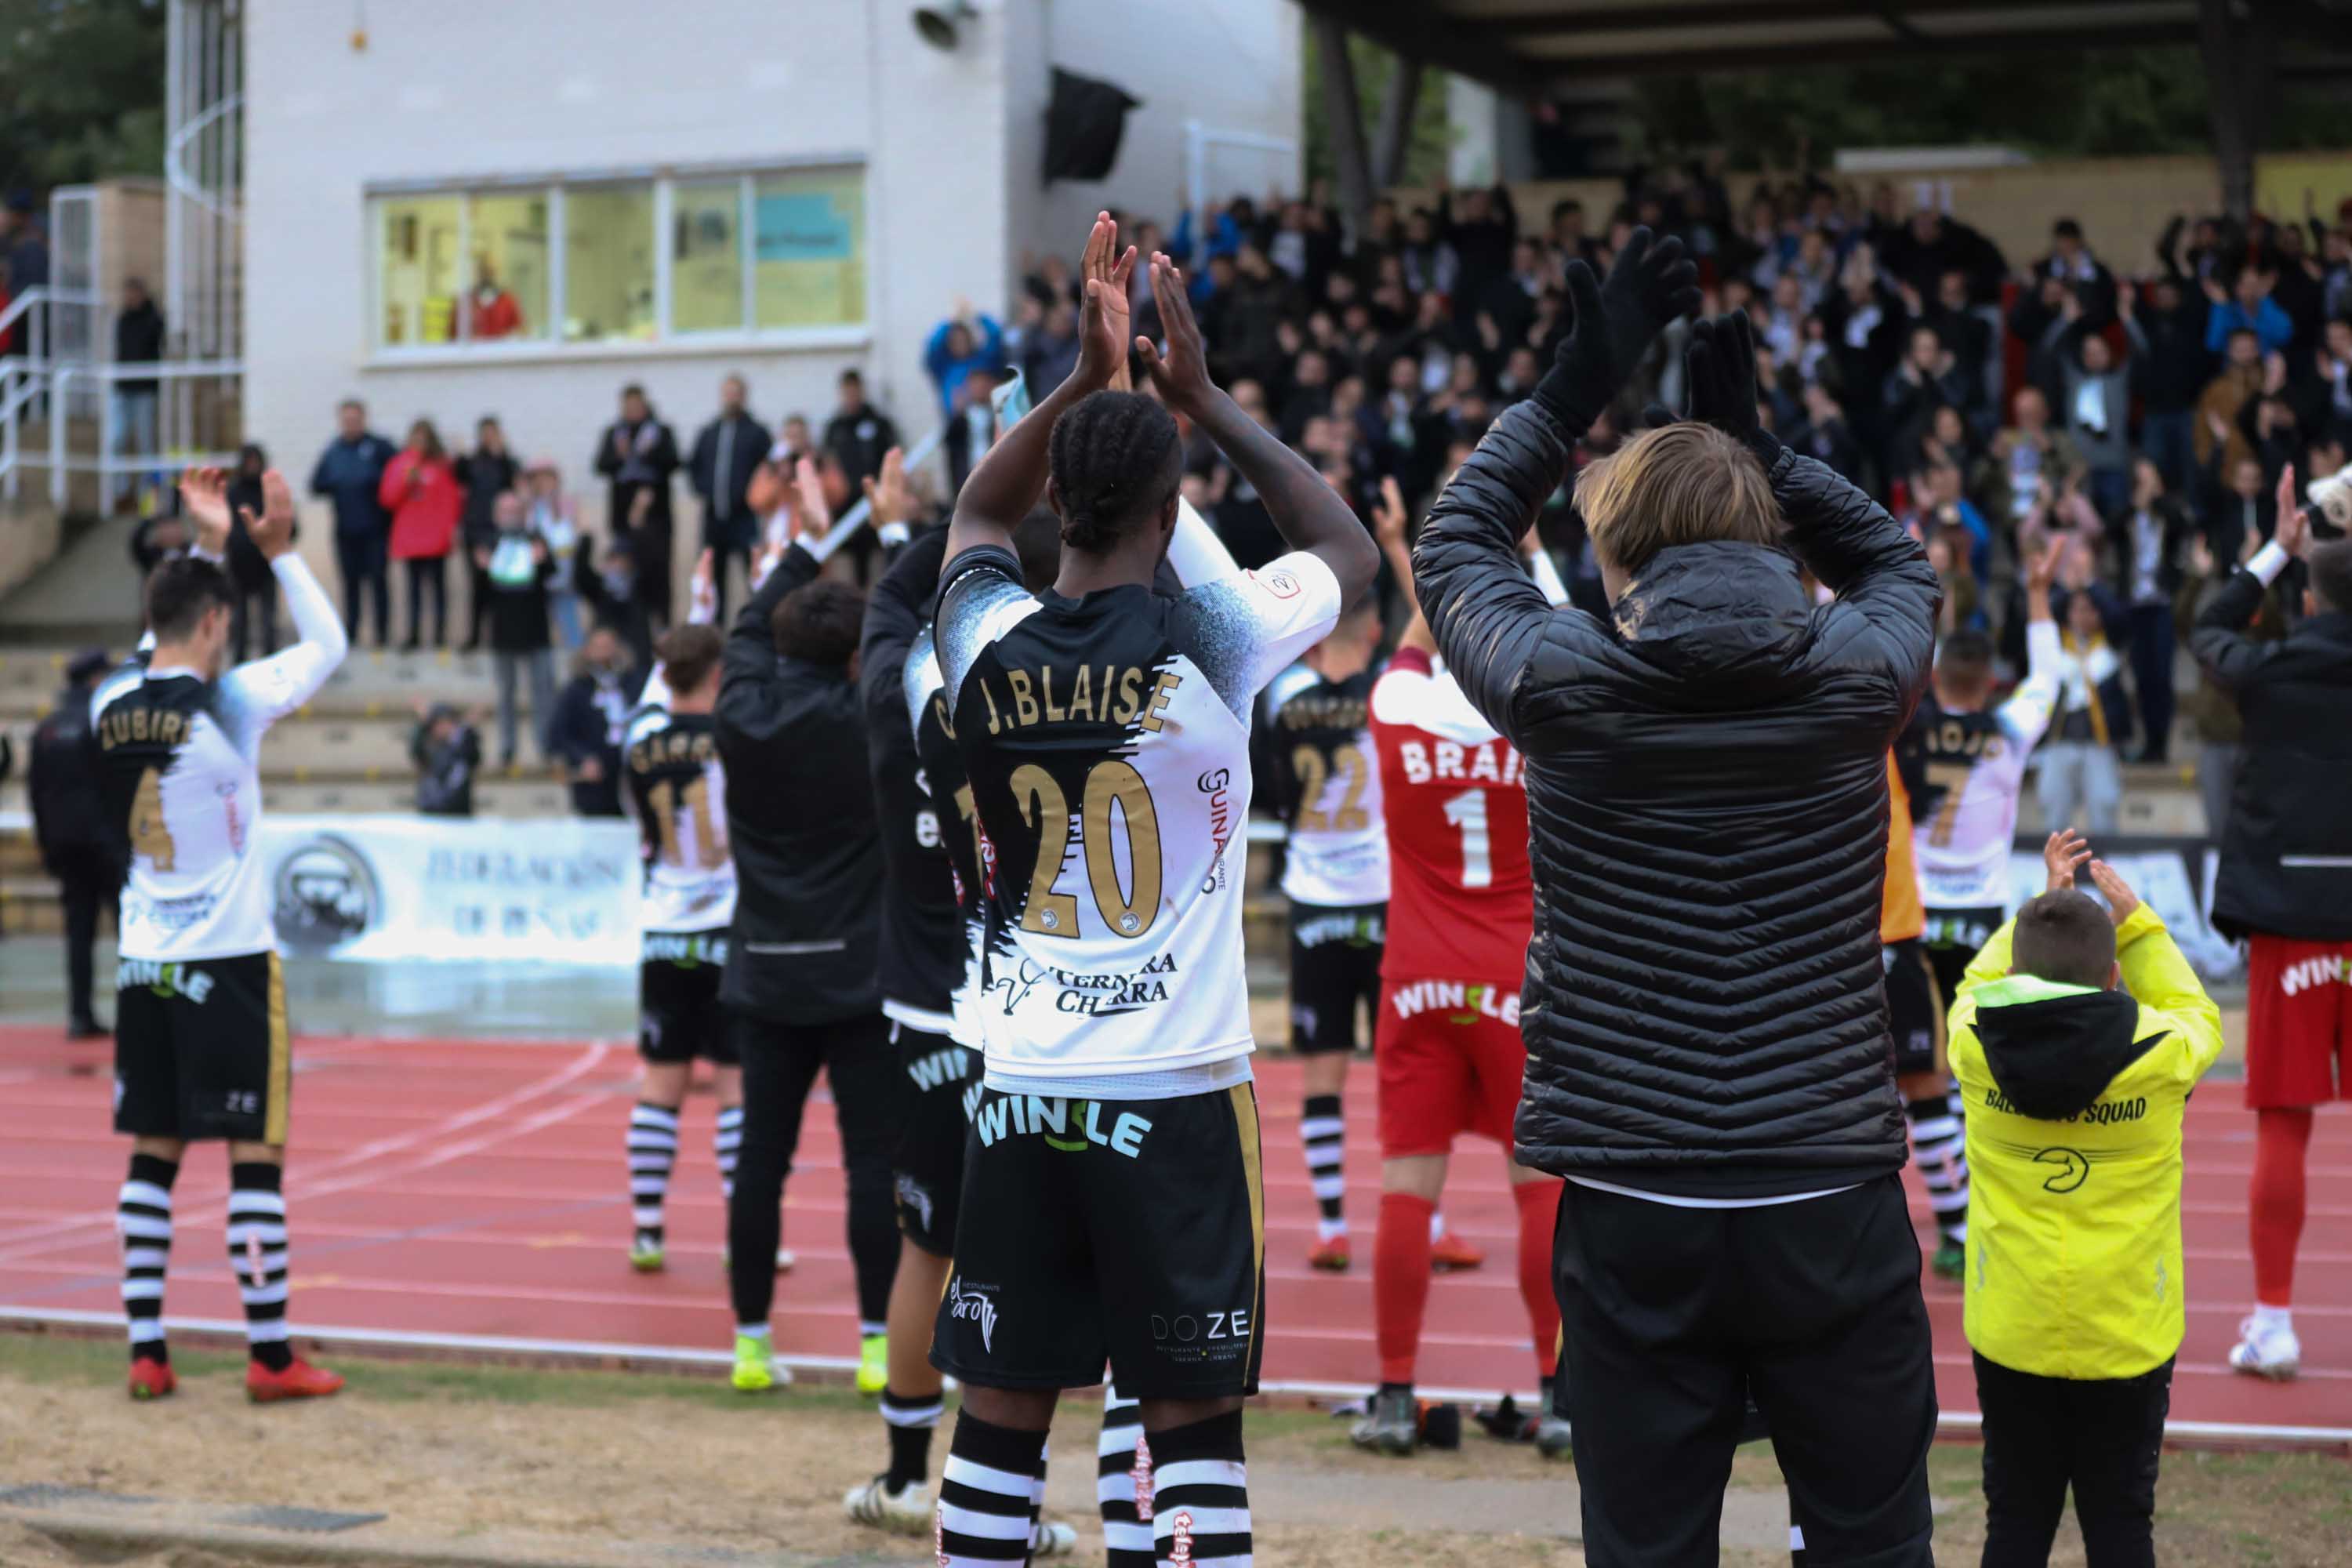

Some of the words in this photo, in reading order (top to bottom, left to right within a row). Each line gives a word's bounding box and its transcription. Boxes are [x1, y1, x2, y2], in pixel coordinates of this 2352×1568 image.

[980, 665, 1183, 735] J.BLAISE
[1293, 746, 1369, 833] 22
[1009, 760, 1163, 938] 20
[1443, 789, 1492, 887] 1
[2084, 1097, 2147, 1126] SQUAD
